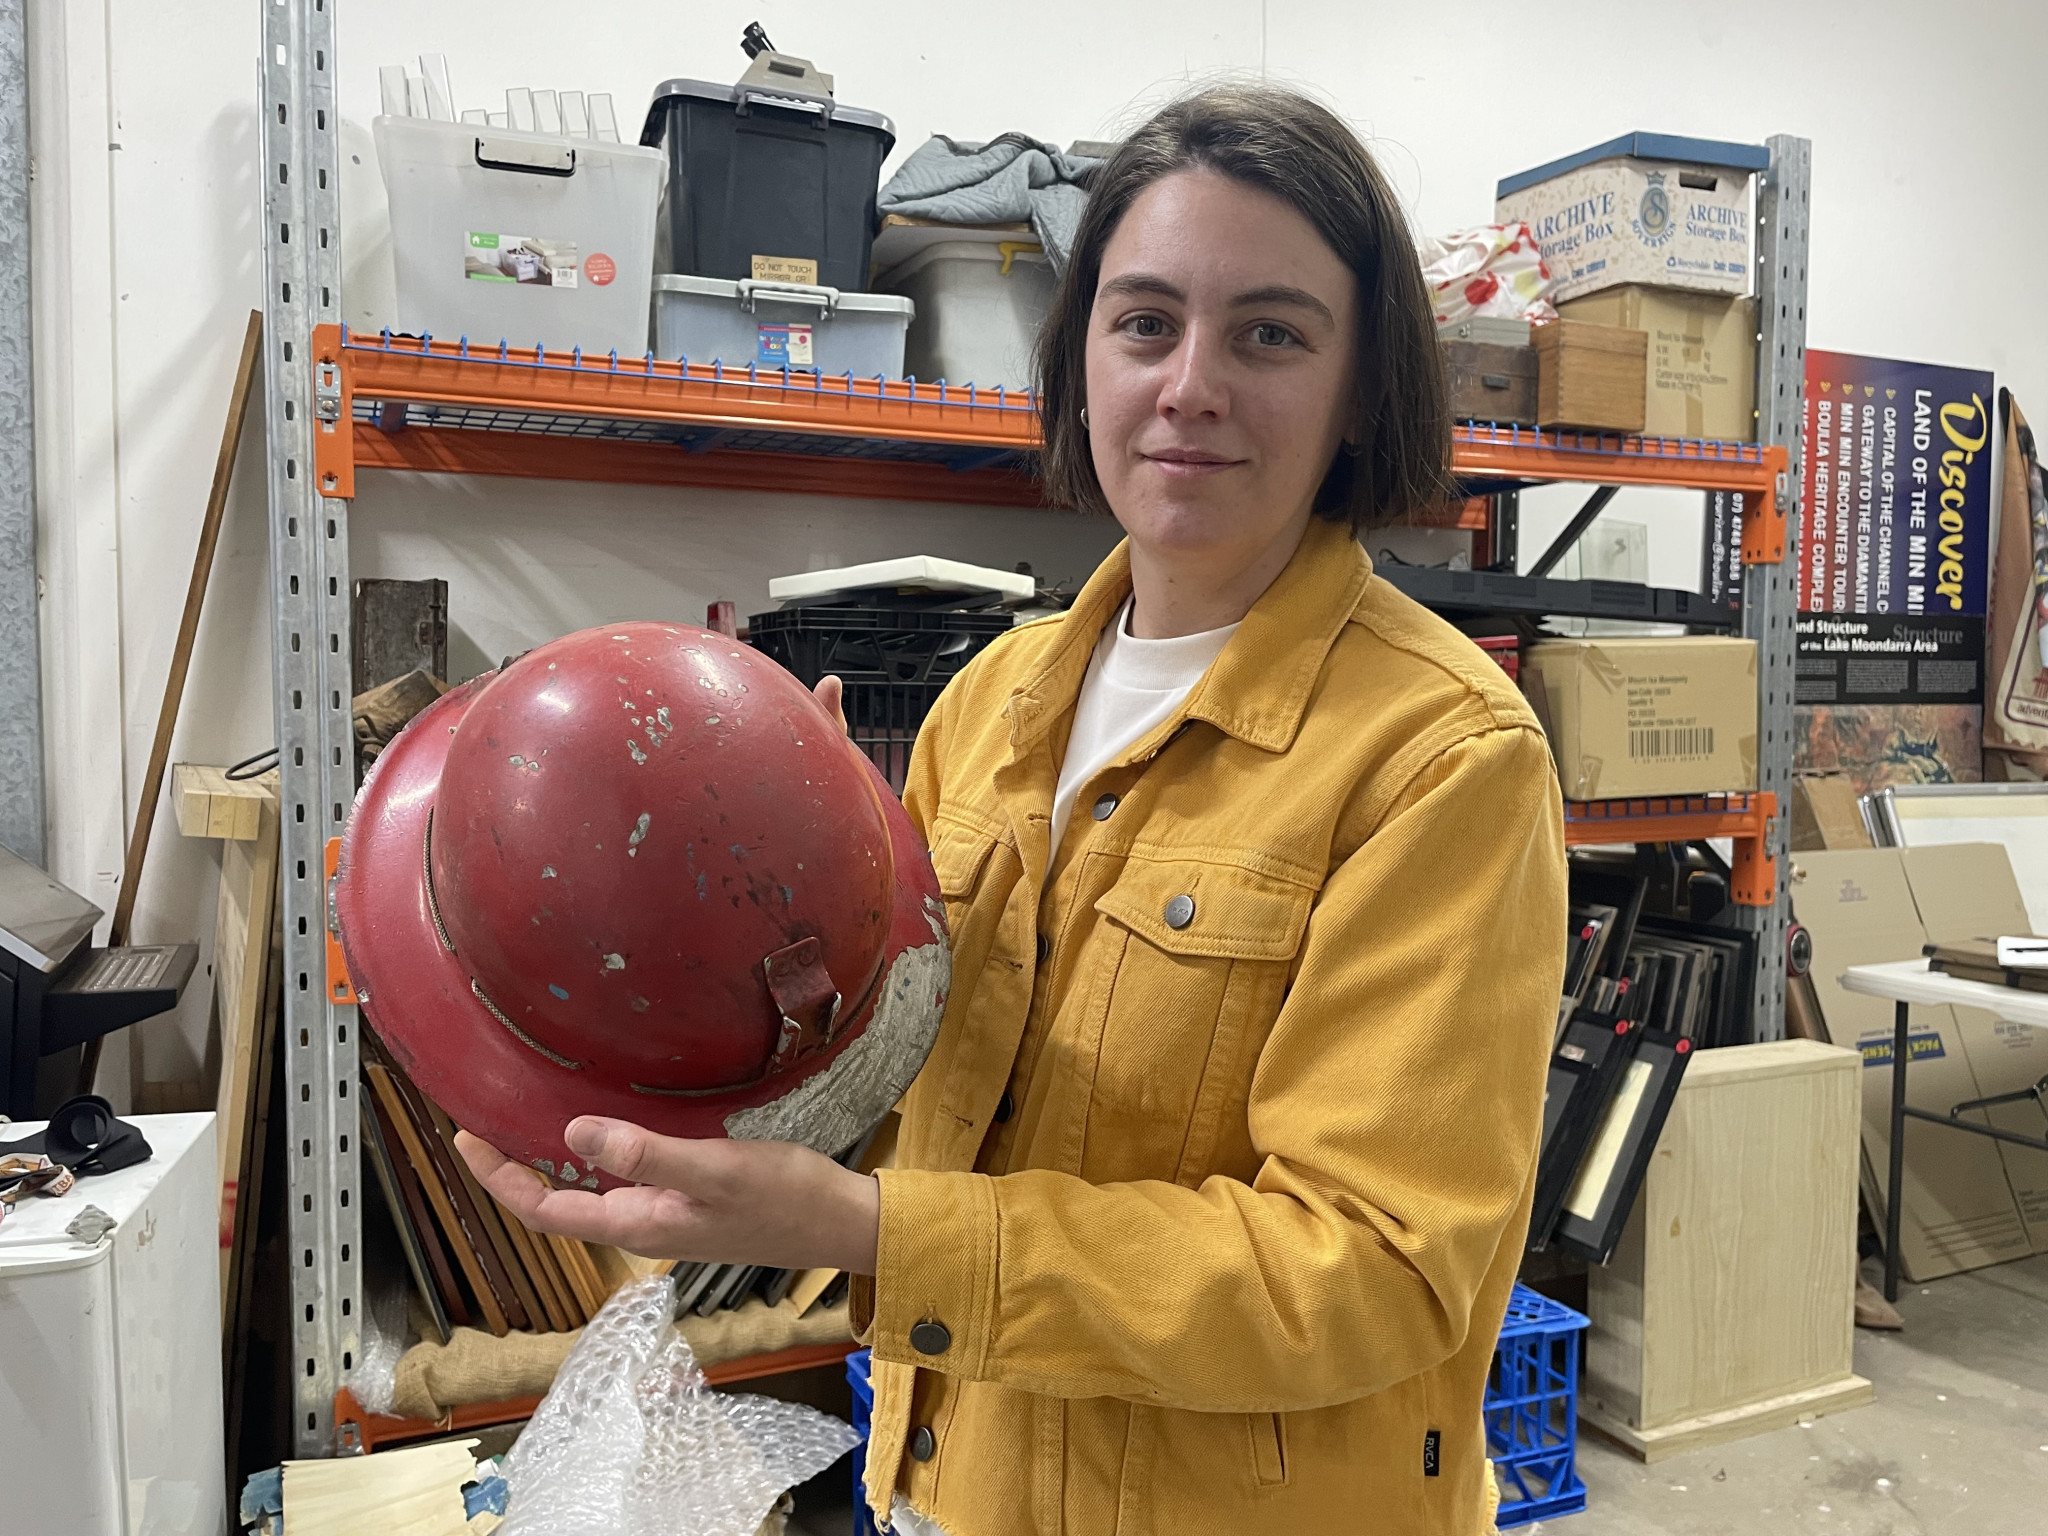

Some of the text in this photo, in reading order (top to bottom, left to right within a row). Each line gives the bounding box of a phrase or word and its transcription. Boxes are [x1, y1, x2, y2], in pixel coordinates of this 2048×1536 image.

[1534, 192, 1615, 241] ARCHIVE
[1686, 204, 1747, 229] ARCHIVE
[1686, 221, 1746, 244] Storage Box
[1539, 221, 1614, 260] torage Box
[1631, 219, 1676, 248] SOVEREIGN
[754, 263, 812, 274] DO NOT TOUCH
[1816, 400, 1831, 458] BOULIA
[1840, 402, 1854, 433] MIN
[1913, 389, 1932, 451] LAND
[1838, 436, 1853, 467] MIN
[1859, 404, 1875, 478] GATEWAY
[1881, 406, 1897, 470] CAPITAL
[1881, 471, 1895, 494] OF
[1911, 456, 1928, 485] OF
[1813, 461, 1829, 541] HERITAGE
[1858, 478, 1873, 501] TO
[1936, 392, 1987, 610] Discover
[1834, 470, 1851, 565] ENCOUNTER
[1857, 502, 1871, 534] THE
[1879, 493, 1894, 525] THE
[1910, 488, 1926, 529] THE
[1877, 526, 1892, 599] CHANNEL
[1908, 535, 1927, 578] MIN
[1816, 619, 1869, 635] Structure
[1893, 623, 1964, 645] Structure
[1824, 637, 1849, 652] Lake
[1851, 638, 1912, 653] Moondarra
[1913, 639, 1939, 653] Area
[1912, 1038, 1939, 1053] PACK
[1425, 1437, 1435, 1469] RVCA
